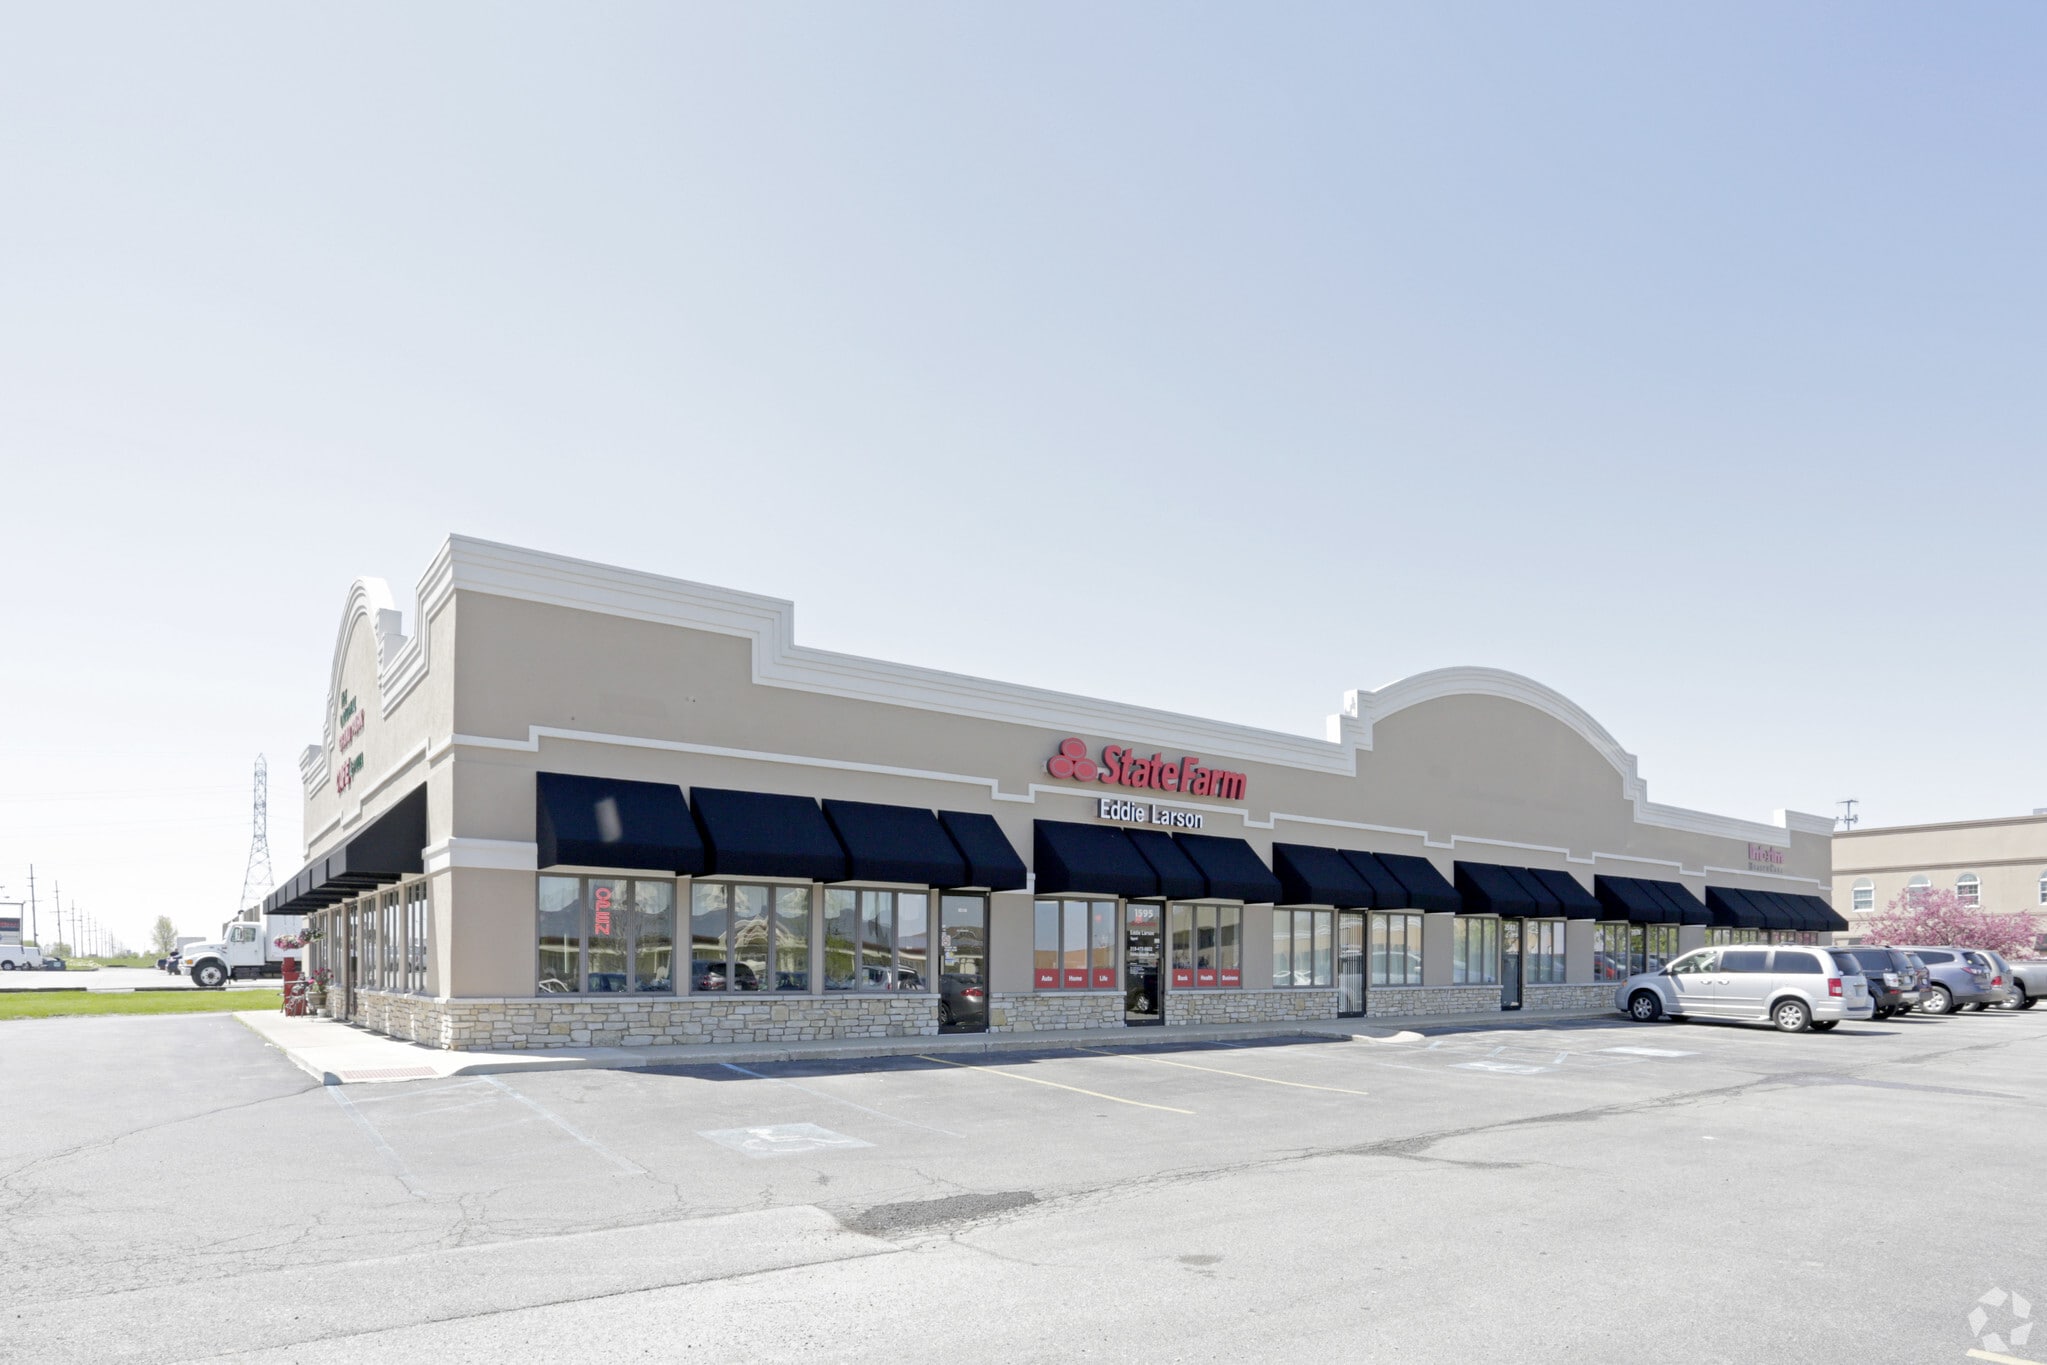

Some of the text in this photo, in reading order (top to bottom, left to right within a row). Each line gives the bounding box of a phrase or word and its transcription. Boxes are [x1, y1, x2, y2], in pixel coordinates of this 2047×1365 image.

[1099, 798, 1204, 828] Eddie Larson
[595, 887, 612, 935] OPEN
[1134, 908, 1154, 918] 1595
